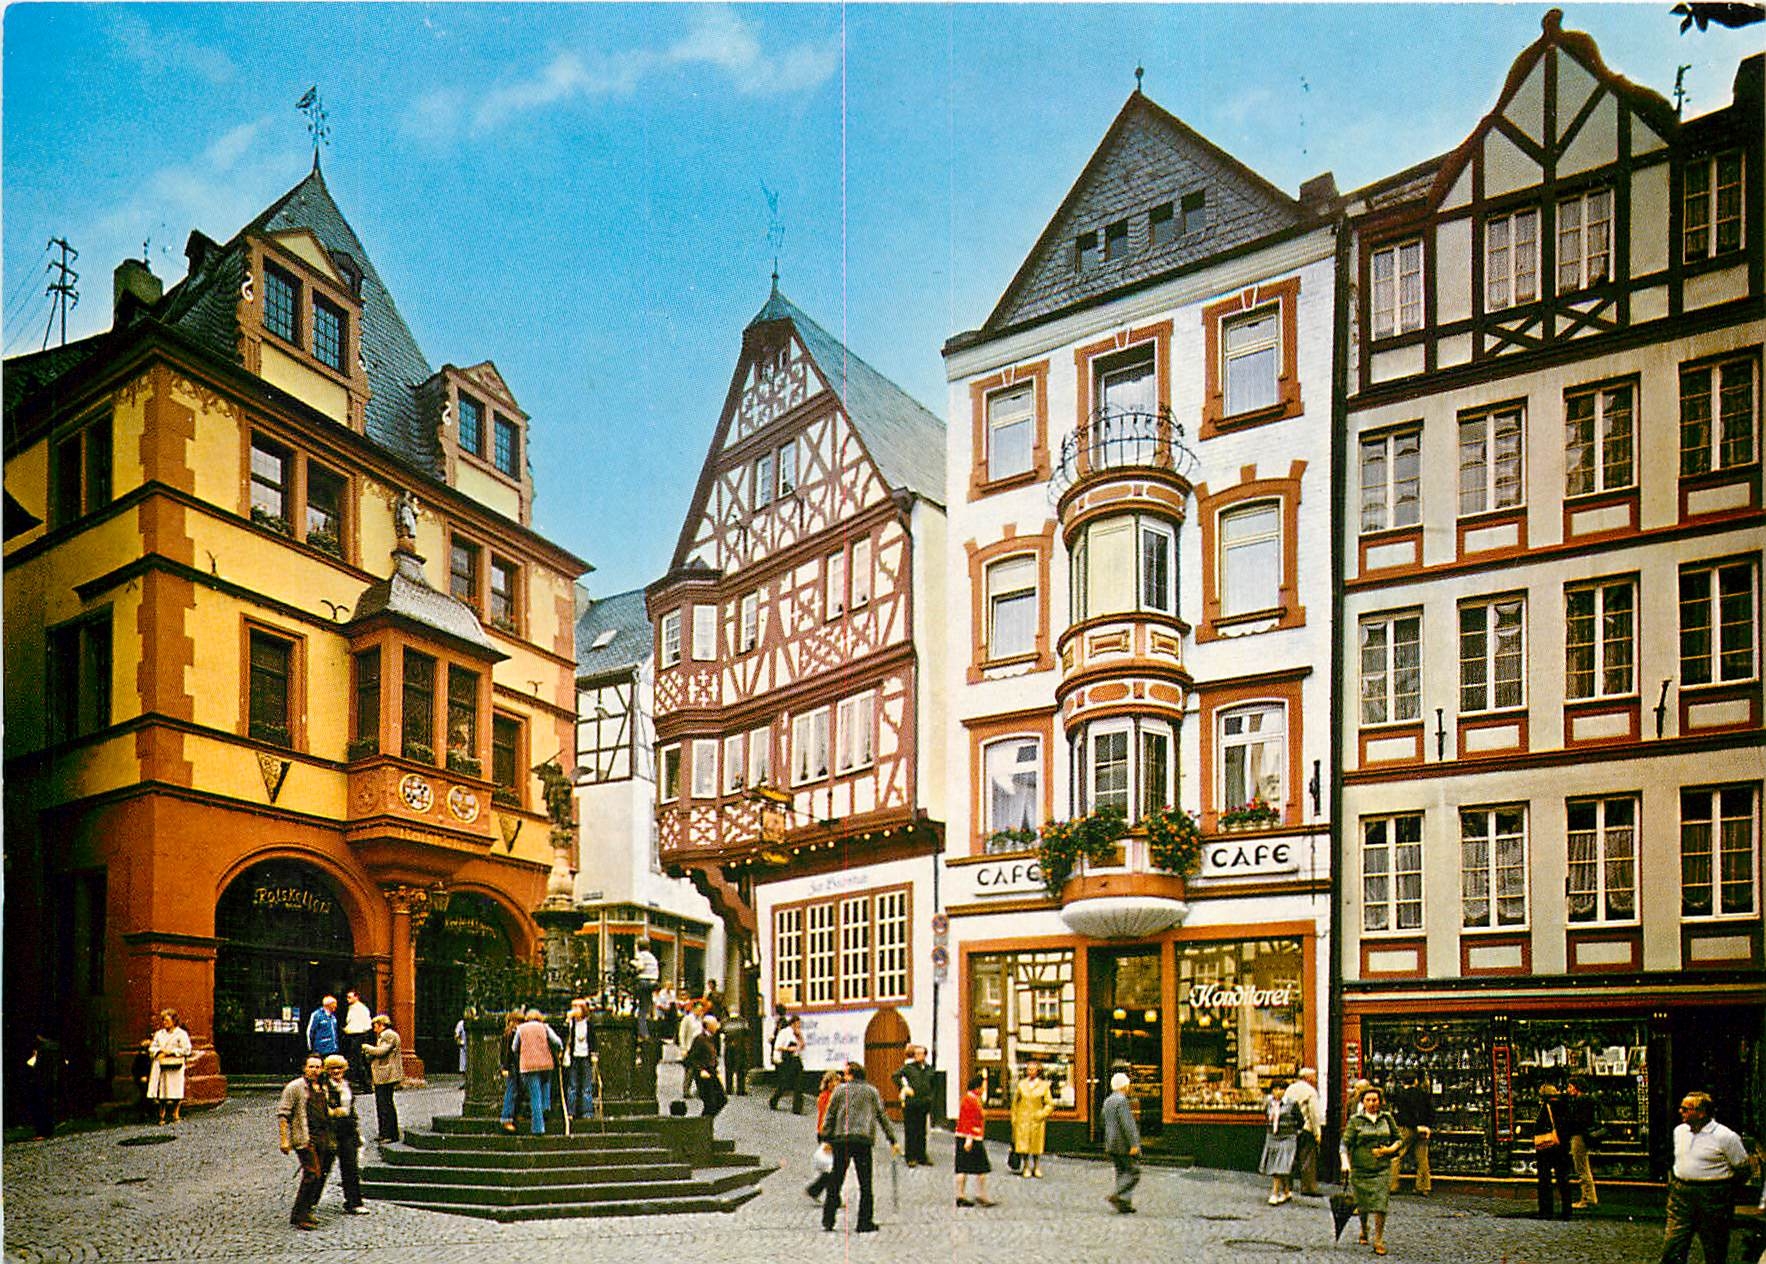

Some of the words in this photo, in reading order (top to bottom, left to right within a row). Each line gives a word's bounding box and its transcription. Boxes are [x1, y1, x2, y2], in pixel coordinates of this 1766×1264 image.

[1211, 844, 1290, 868] CAFE
[977, 863, 1041, 886] CAFE
[1189, 984, 1292, 1009] Konditorei
